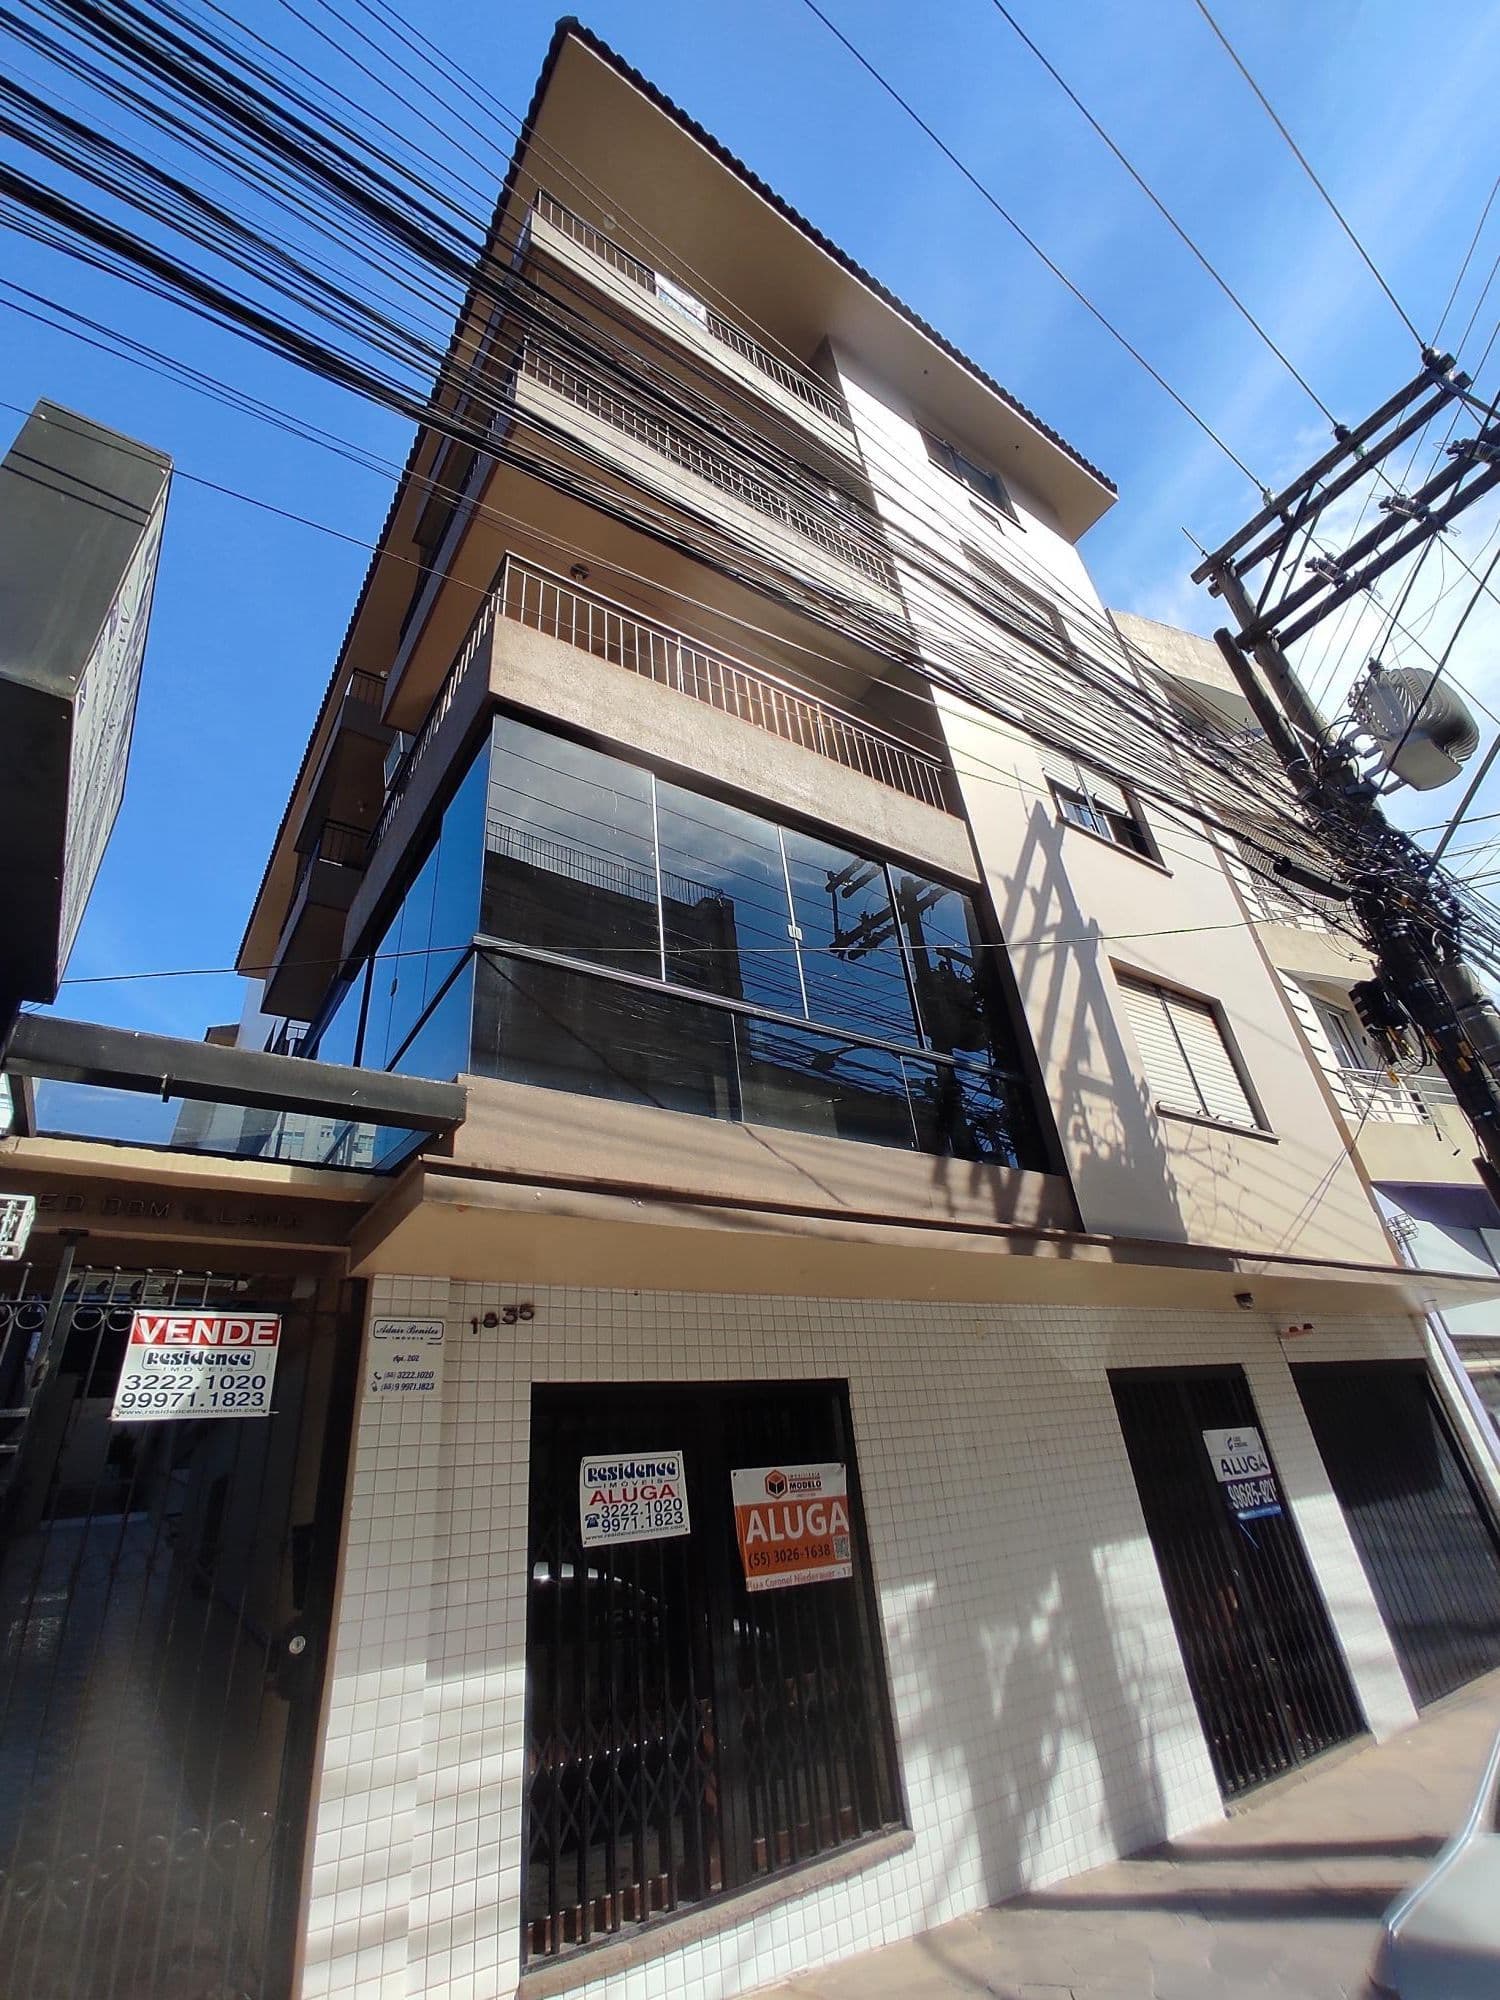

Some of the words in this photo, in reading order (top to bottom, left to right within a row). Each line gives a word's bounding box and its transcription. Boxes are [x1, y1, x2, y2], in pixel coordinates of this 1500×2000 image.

[139, 1318, 276, 1345] VENDE
[147, 1350, 252, 1366] Residence
[124, 1374, 266, 1391] 3222.1020
[121, 1392, 265, 1408] 99971.1823
[588, 1462, 676, 1482] Residence
[1221, 1453, 1269, 1477] ALUGA
[589, 1484, 676, 1506] ALUGA
[789, 1479, 822, 1490] MODELO
[601, 1497, 683, 1519] 3222.1020
[601, 1511, 684, 1533] 9971.1823
[746, 1501, 850, 1545] ALUGA
[748, 1553, 770, 1569] (55)
[774, 1544, 831, 1564] 3026-1638
